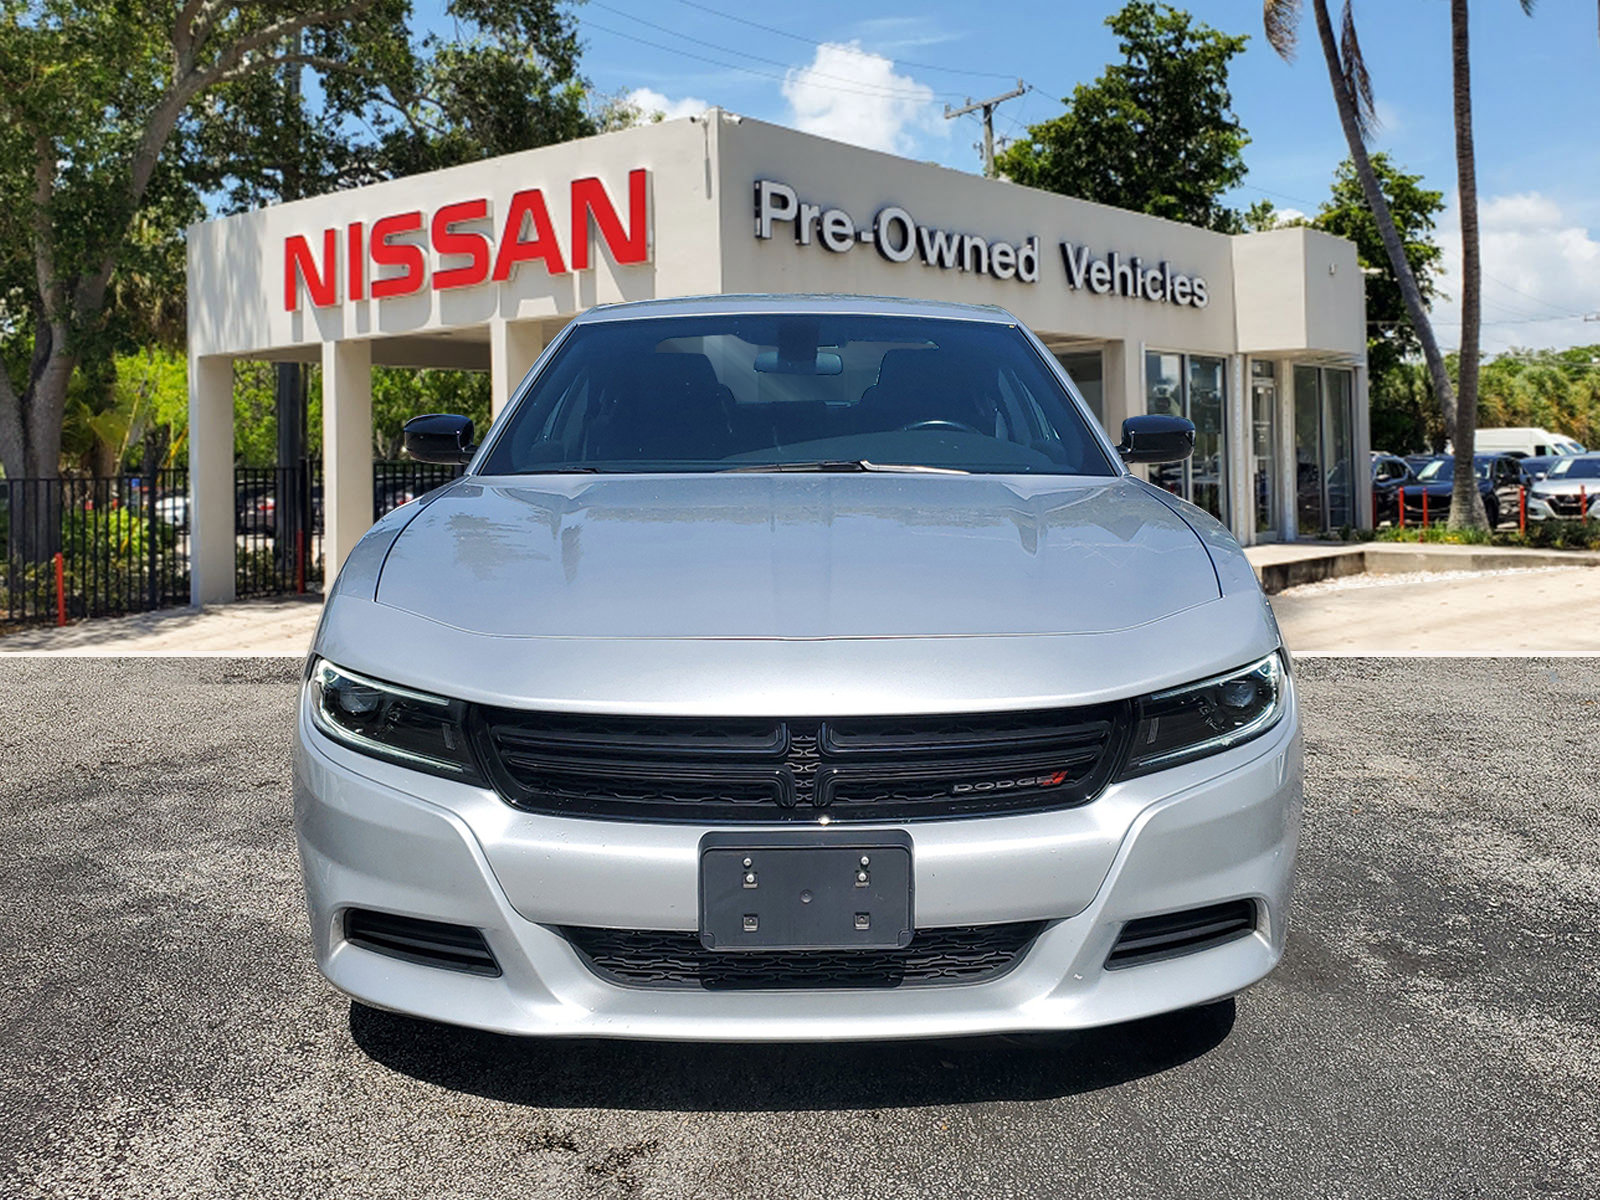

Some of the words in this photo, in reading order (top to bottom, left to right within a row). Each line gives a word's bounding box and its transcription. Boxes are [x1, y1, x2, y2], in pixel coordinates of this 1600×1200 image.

[284, 168, 649, 312] NISSAN
[754, 179, 1040, 284] Pre-Owned
[1060, 242, 1209, 309] Vehicles
[953, 775, 1053, 792] DODGE
